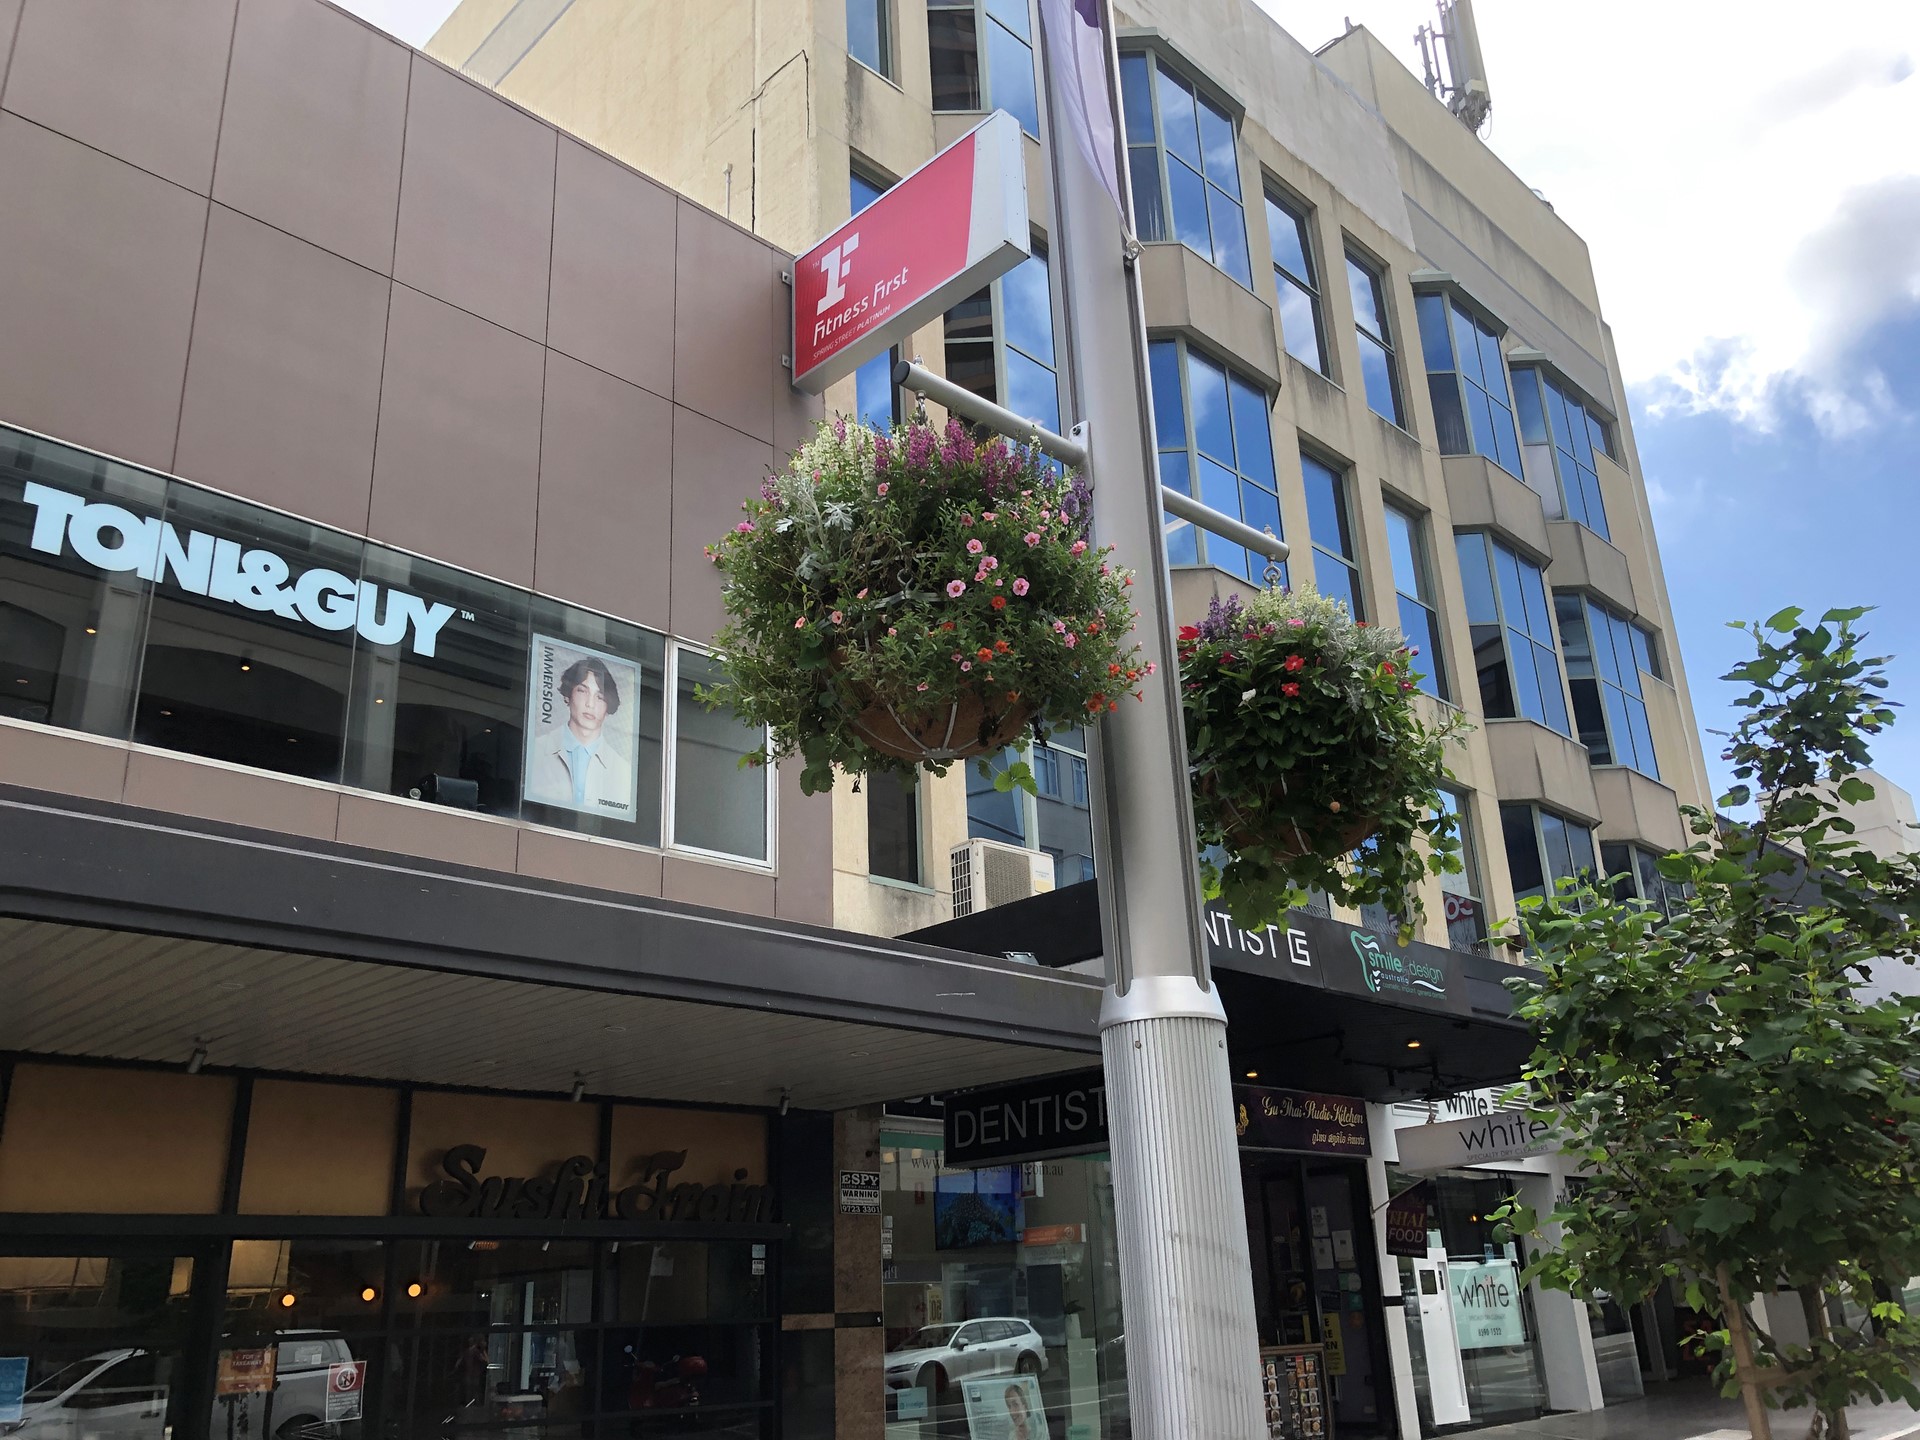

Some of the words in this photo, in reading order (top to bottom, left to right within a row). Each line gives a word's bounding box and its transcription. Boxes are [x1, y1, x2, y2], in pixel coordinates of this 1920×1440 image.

[813, 295, 869, 347] Fitness
[872, 266, 909, 308] First
[813, 341, 834, 360] SPRING
[834, 325, 857, 346] STREET
[856, 303, 891, 332] PLATINUM
[22, 480, 457, 659] TONI&GUY
[541, 645, 554, 725] IMMERSION
[597, 797, 629, 812] TONI&GUY
[1368, 951, 1403, 974] smile
[1408, 960, 1444, 984] design
[1381, 971, 1410, 986] australia
[954, 1085, 1106, 1149] DENTIST
[1280, 1096, 1303, 1118] Thai
[1303, 1100, 1332, 1121] Studio
[1330, 1103, 1364, 1128] Kitchen
[1445, 1089, 1489, 1117] white
[1458, 1114, 1549, 1151] white
[1467, 1151, 1499, 1161] SPECIALTY
[1501, 1149, 1513, 1157] DRY
[420, 1143, 606, 1220] Sushi
[614, 1148, 780, 1223] Train
[841, 1173, 879, 1186] ESPY
[842, 1189, 879, 1198] WARNING
[842, 1205, 861, 1213] 9723
[1388, 1210, 1425, 1228] THAI
[1387, 1227, 1425, 1244] FOOD
[1457, 1274, 1510, 1309] white
